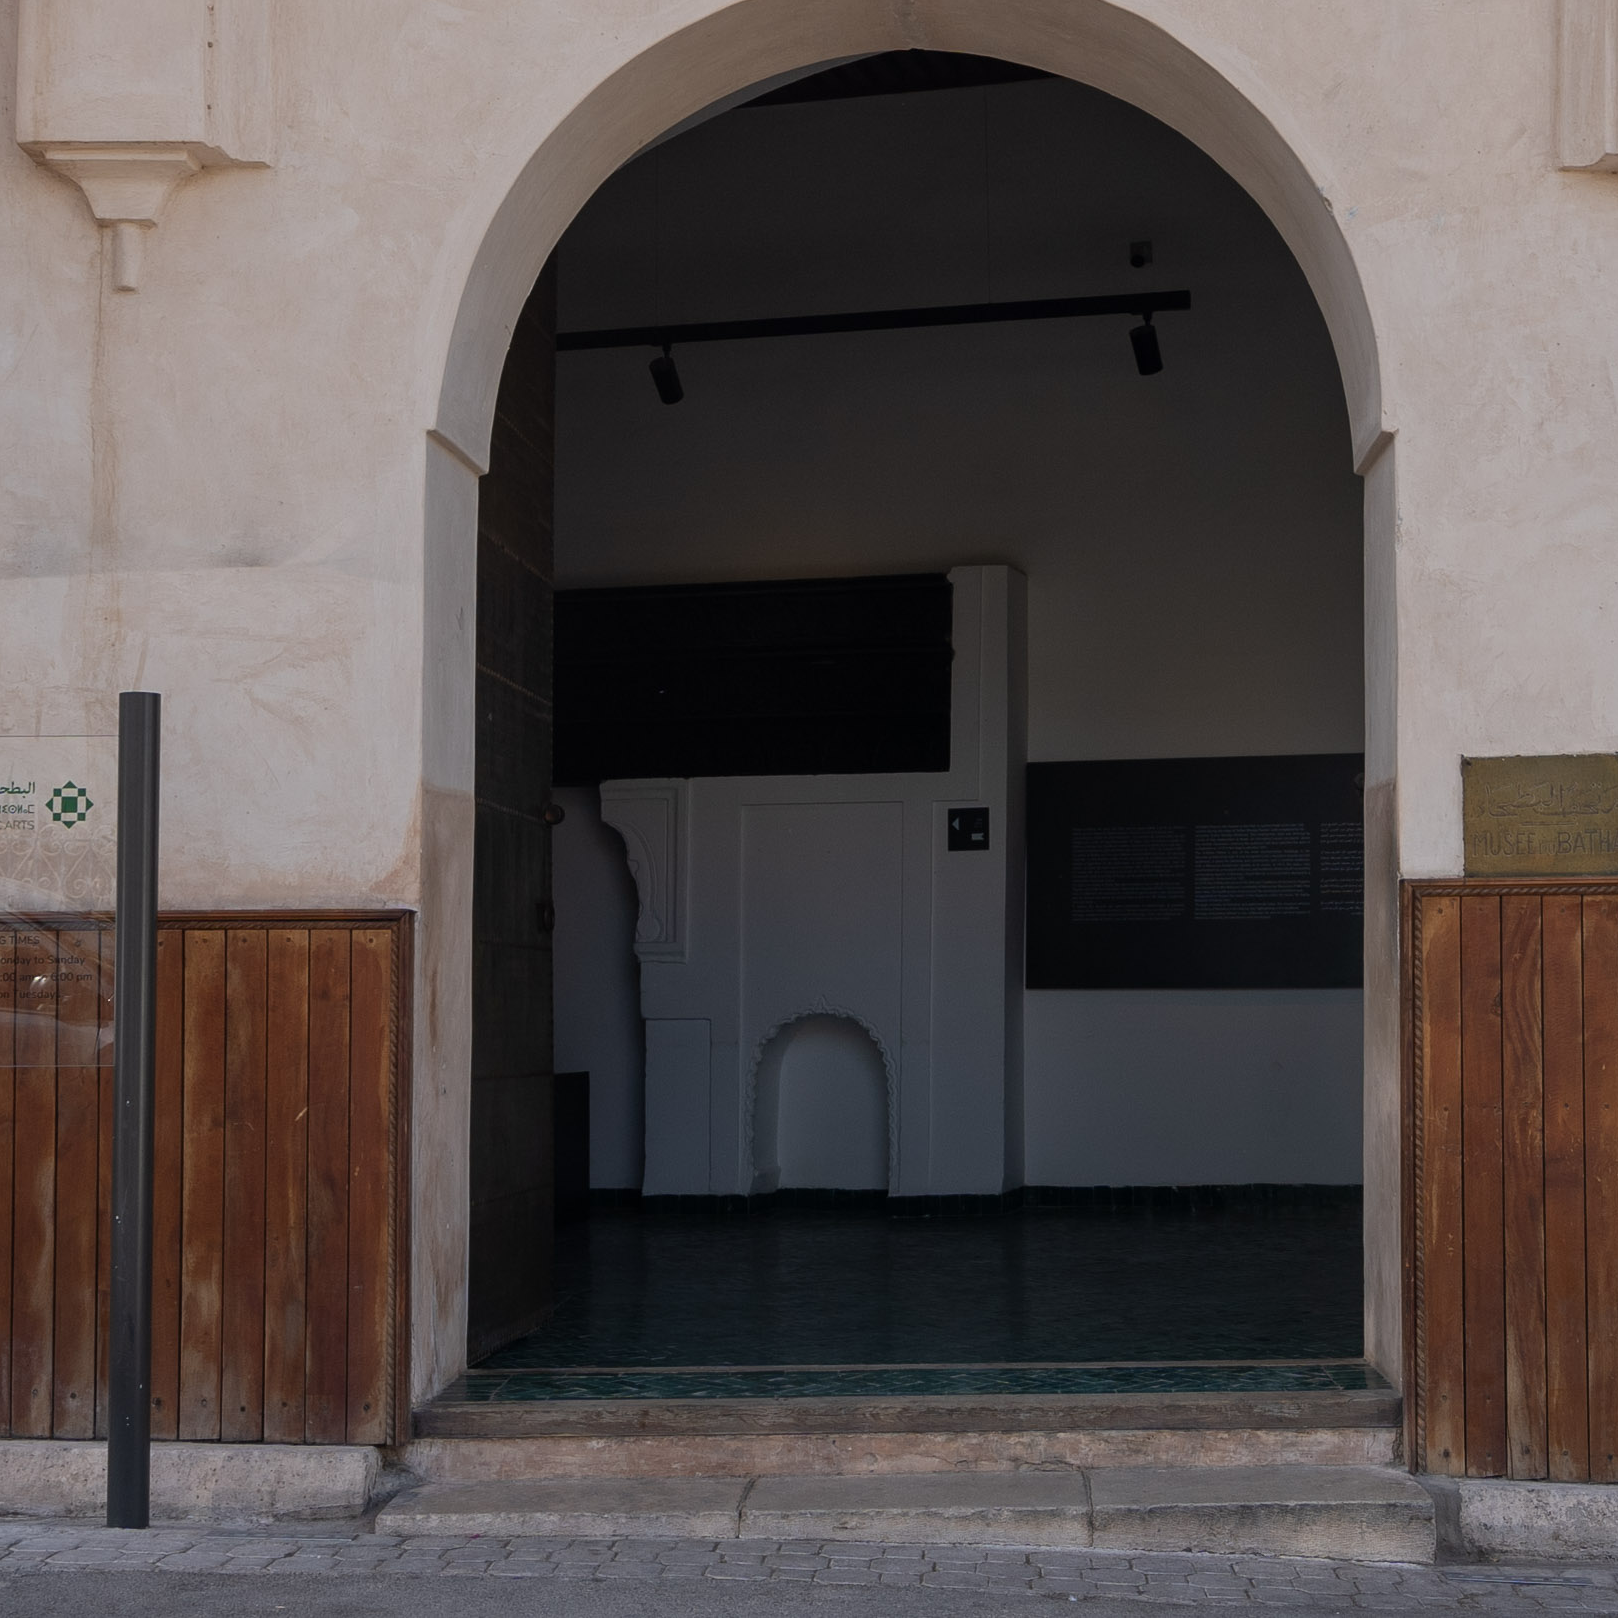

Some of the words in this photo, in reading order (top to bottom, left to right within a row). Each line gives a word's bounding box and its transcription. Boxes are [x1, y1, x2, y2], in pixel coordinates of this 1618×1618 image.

[4, 820, 35, 831] ARTS
[9, 936, 40, 945] TIMES
[34, 956, 44, 965] to
[47, 955, 86, 965] Sunday
[76, 974, 93, 983] pm
